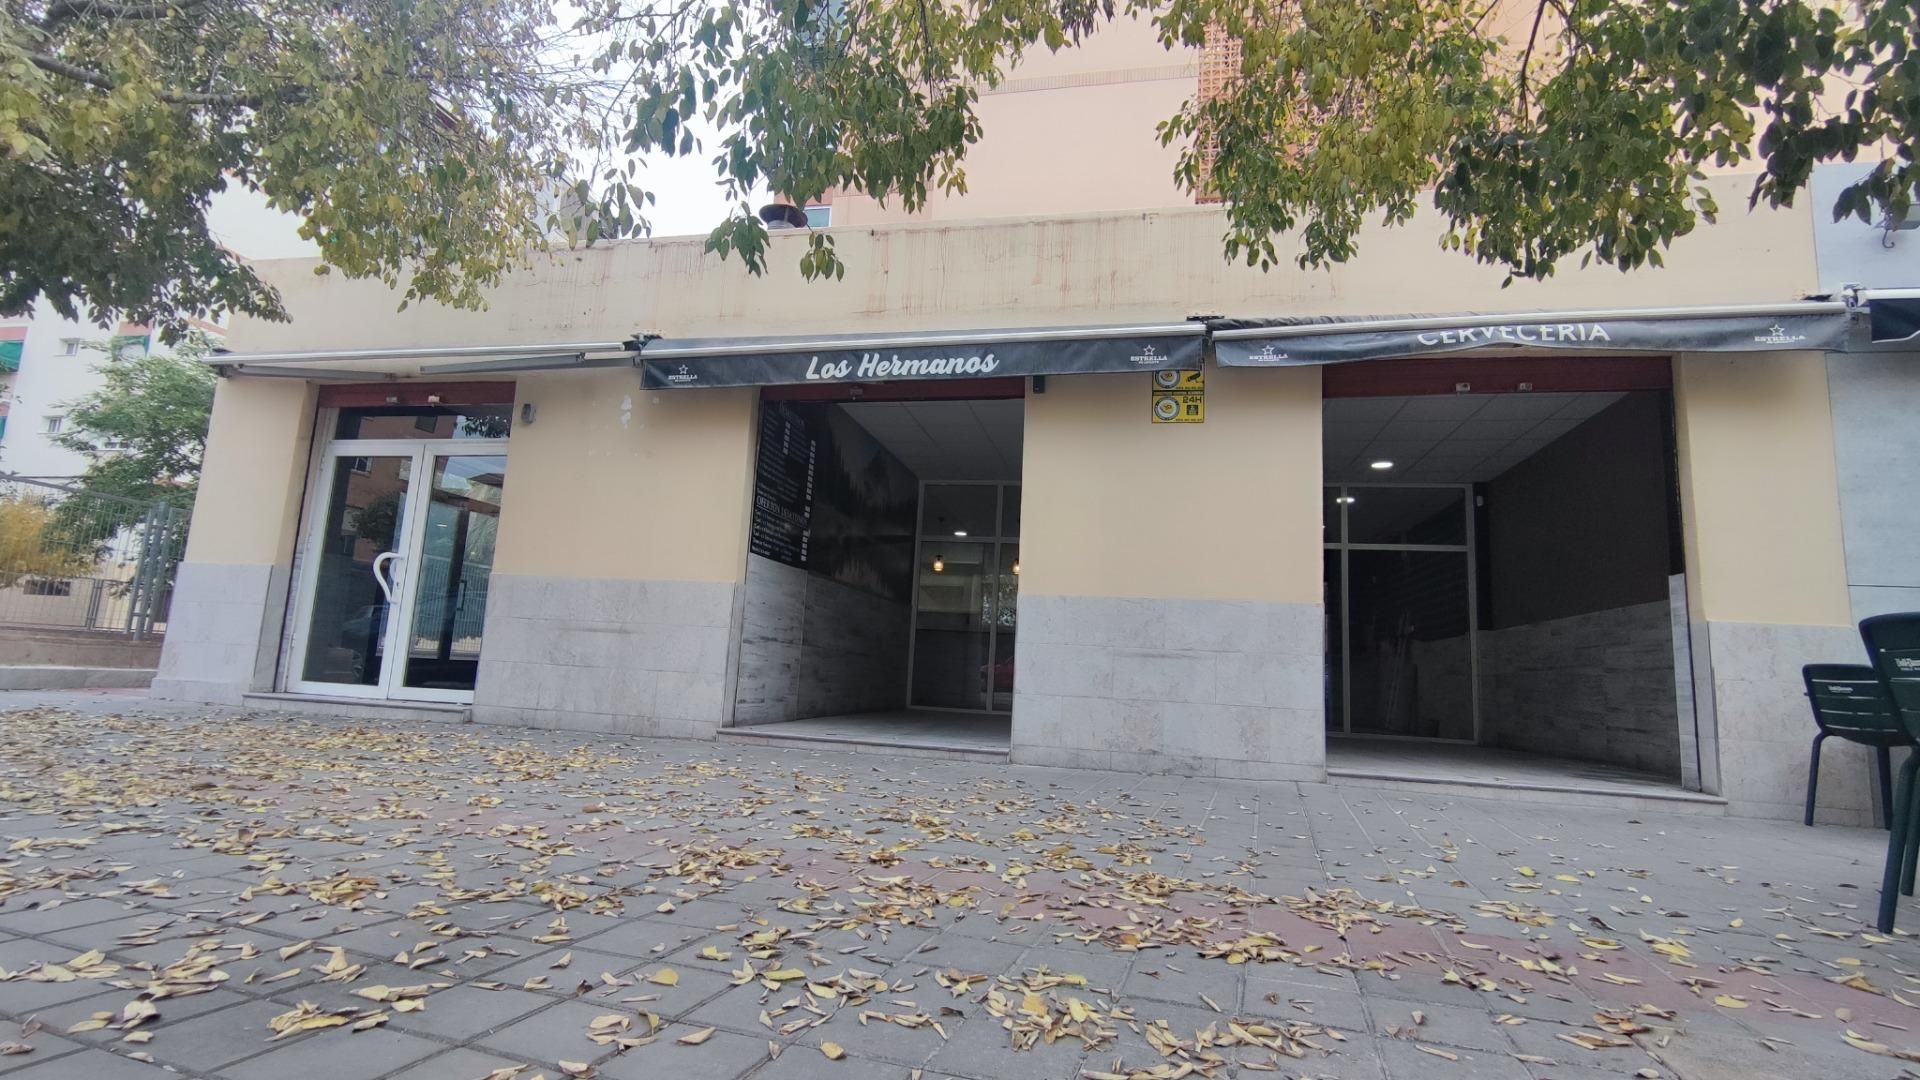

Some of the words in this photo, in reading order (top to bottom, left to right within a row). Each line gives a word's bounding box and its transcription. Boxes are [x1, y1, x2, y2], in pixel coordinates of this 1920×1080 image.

[1417, 324, 1611, 346] CERVECERIA
[806, 356, 852, 380] Los
[857, 353, 999, 378] Hermanos
[1183, 396, 1202, 404] 24H
